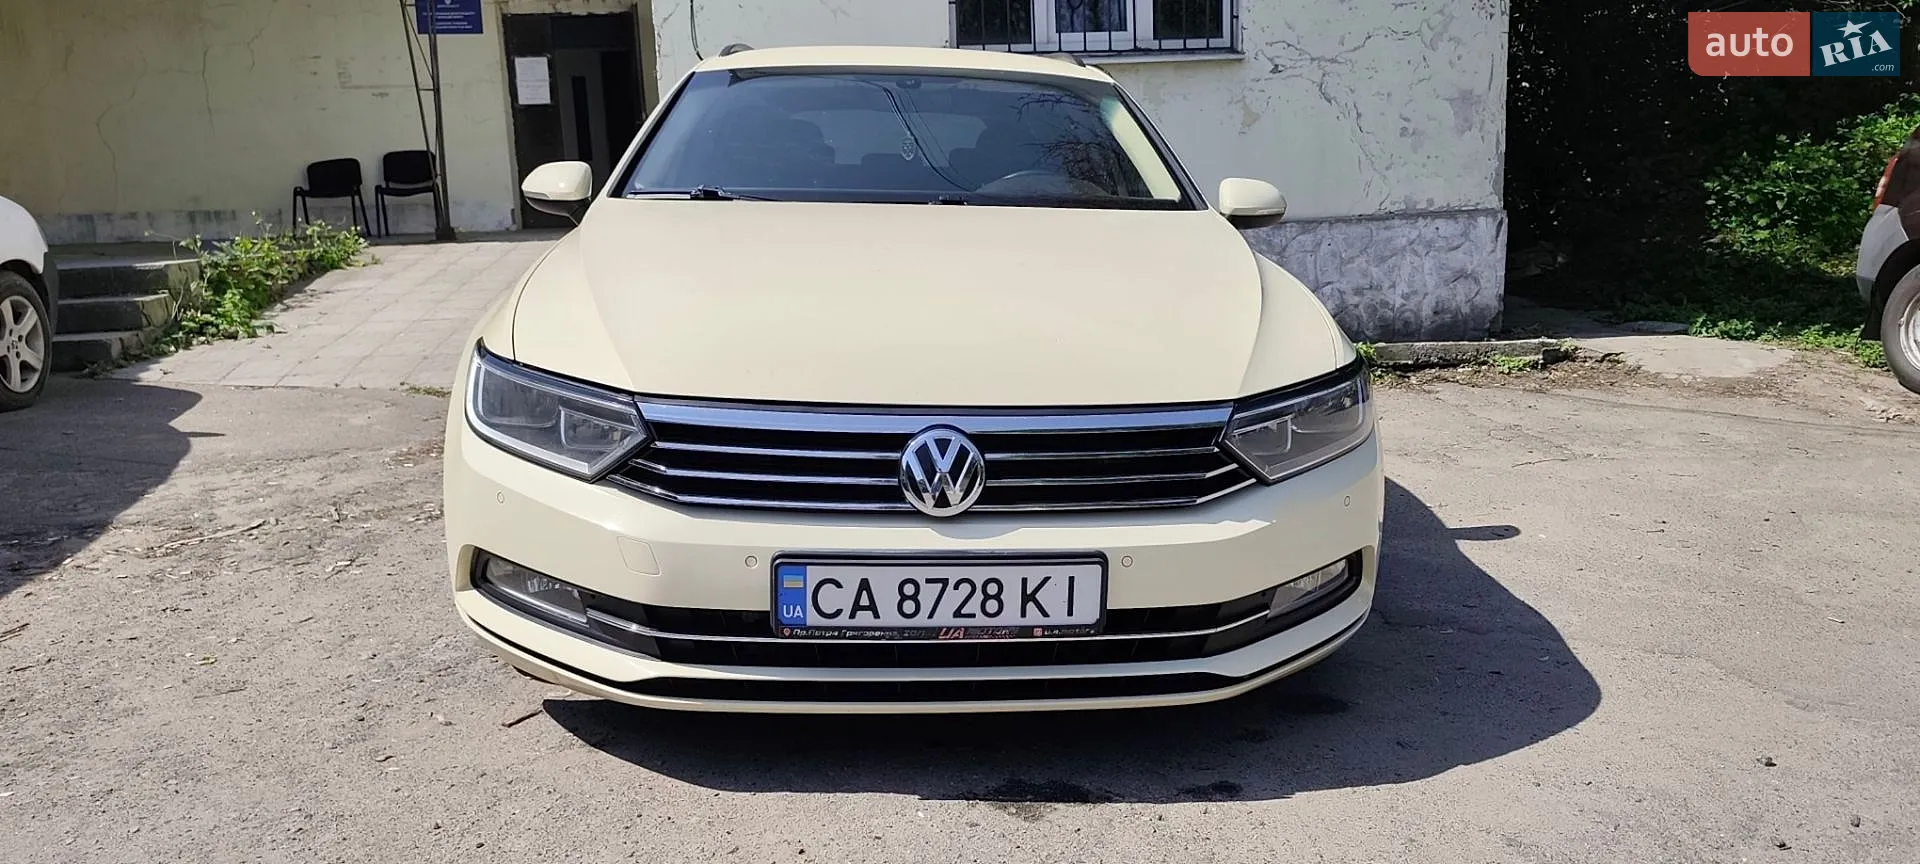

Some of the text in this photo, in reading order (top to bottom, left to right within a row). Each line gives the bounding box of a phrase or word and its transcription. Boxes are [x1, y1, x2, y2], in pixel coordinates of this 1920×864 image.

[811, 575, 1075, 619] CA 8728 KI
[783, 605, 803, 618] UA
